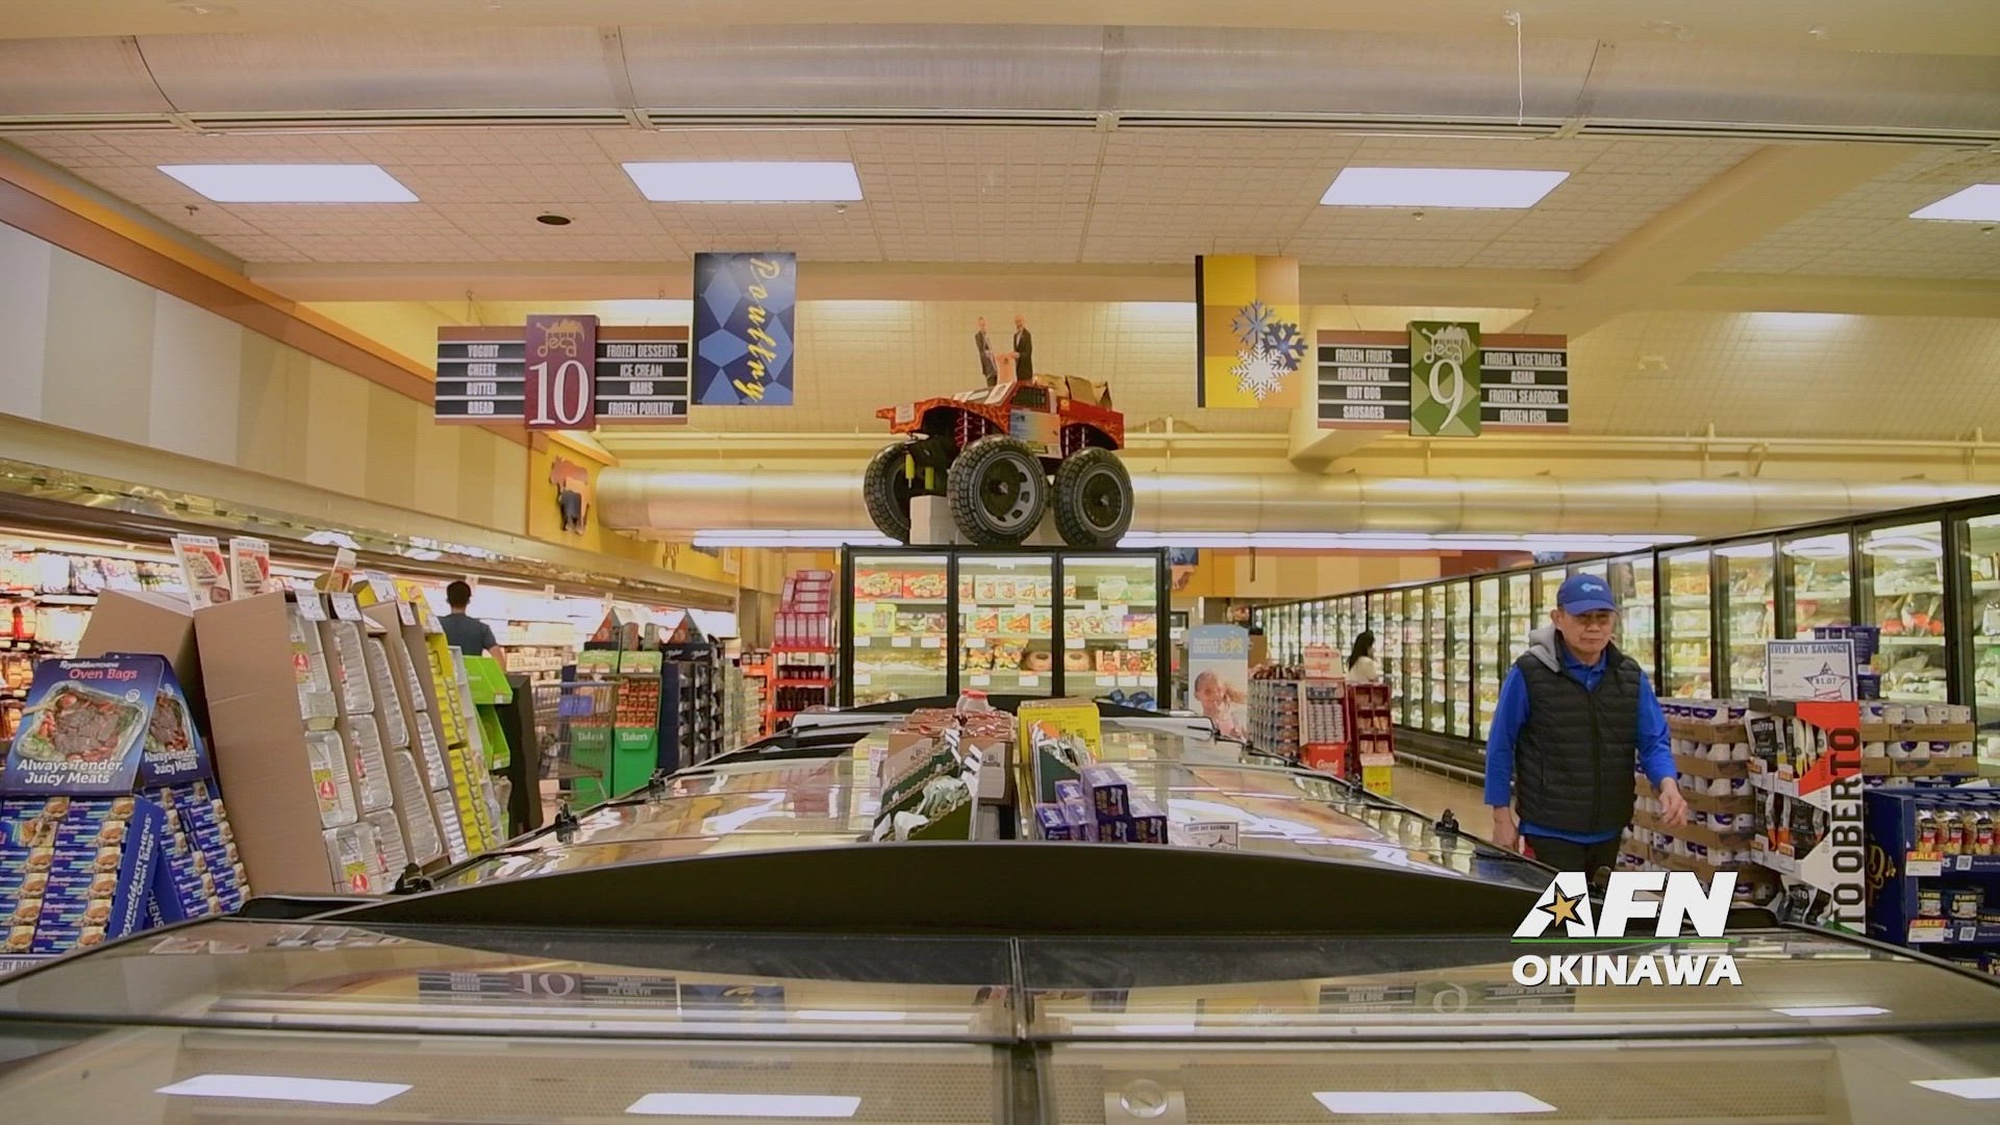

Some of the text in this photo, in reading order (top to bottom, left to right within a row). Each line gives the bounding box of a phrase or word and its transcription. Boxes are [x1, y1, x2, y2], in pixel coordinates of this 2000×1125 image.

[733, 258, 780, 403] Poultry
[467, 345, 499, 358] YOGURT
[607, 344, 678, 358] FROZEN DESSERTS
[1336, 349, 1392, 363] FROZEN FRUITS
[1485, 352, 1562, 367] FROZEN VEGETABLES
[467, 363, 497, 376] CHEESE
[620, 364, 663, 377] ICE CREAM
[1338, 367, 1390, 381] FROZEN PORK
[1511, 371, 1535, 383] ASIAN
[466, 382, 497, 395] BUTTER
[529, 360, 589, 425] 10
[1347, 386, 1381, 399] HOT DOG
[1429, 359, 1463, 430] 9
[1489, 389, 1559, 403] FROZEN SEAFOODS
[467, 401, 494, 414] BREAD
[608, 402, 674, 415] FROZEN POULTRY
[1343, 405, 1384, 419] SAUSAGES
[1500, 409, 1547, 423] FROZEN FISH
[1770, 644, 1847, 654] EVERY DAY SAVINGS
[69, 669, 138, 681] Oven Bags
[17, 759, 124, 772] Always Tender,
[25, 772, 110, 787] Juicy Meats
[1829, 728, 1864, 873] OBERTO
[1910, 852, 1937, 860] SALE
[1914, 919, 1941, 927] SALE
